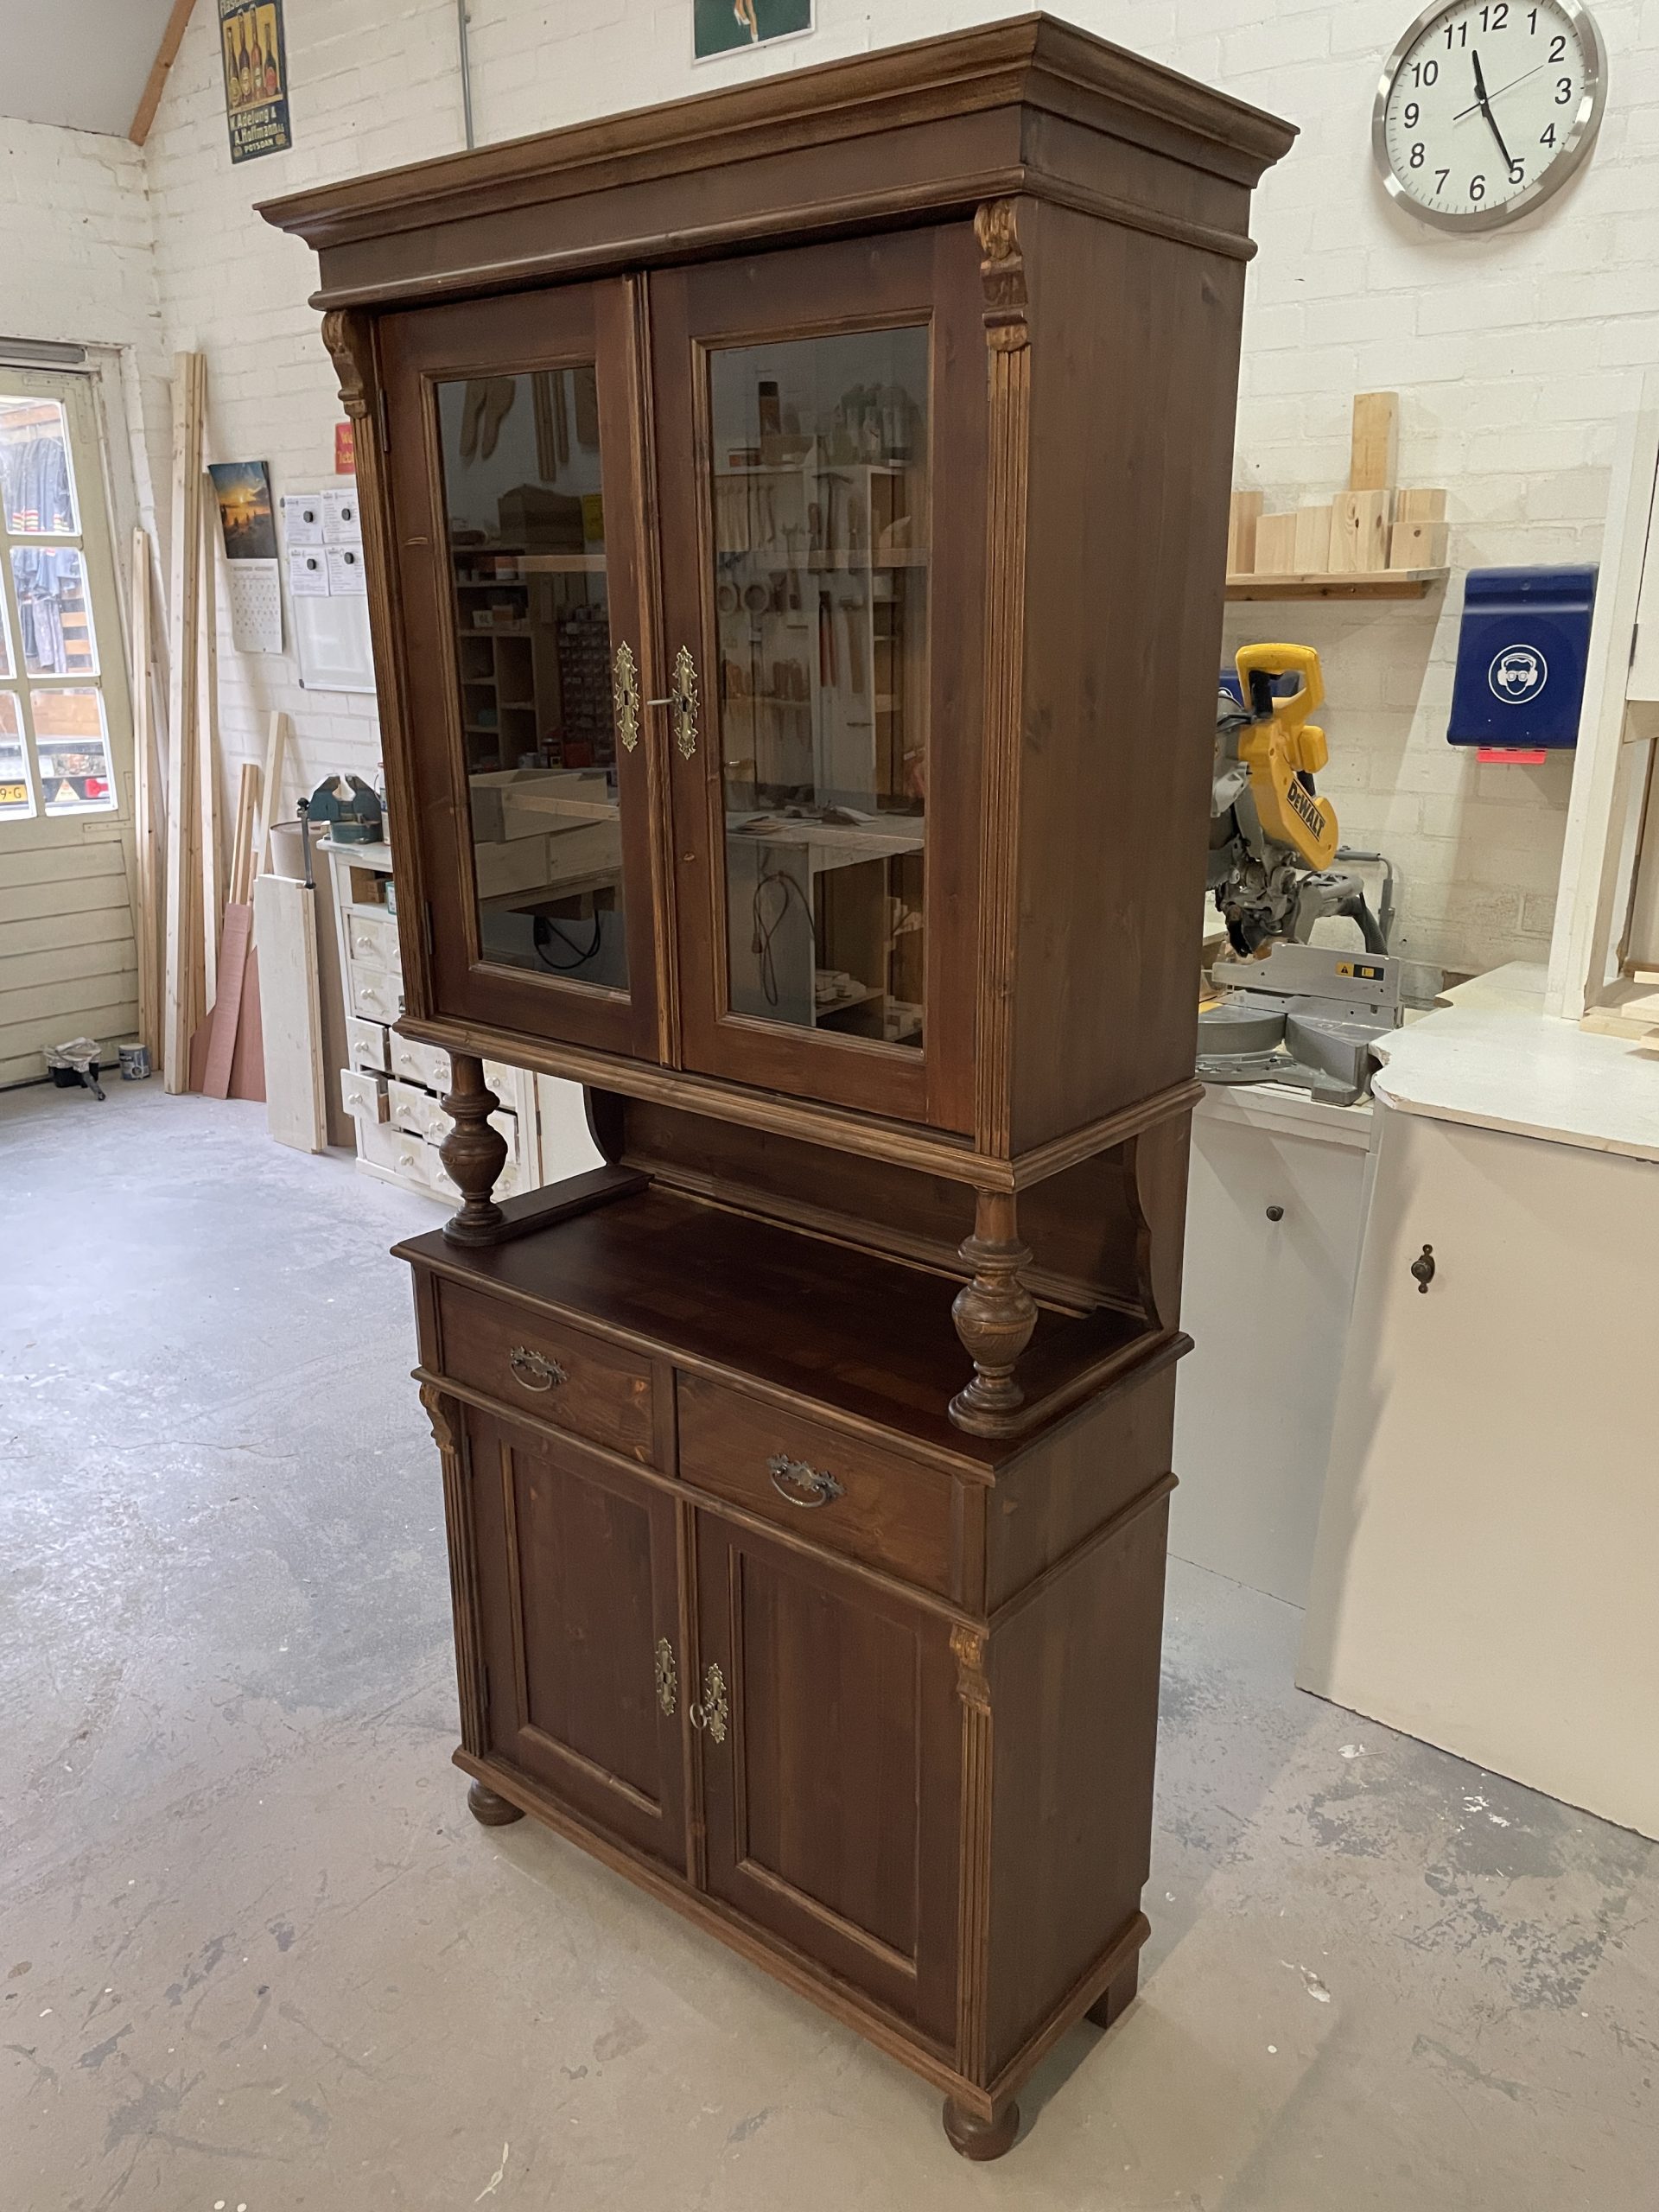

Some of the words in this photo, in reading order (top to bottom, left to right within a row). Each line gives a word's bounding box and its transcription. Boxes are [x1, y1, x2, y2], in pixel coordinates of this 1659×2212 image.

[1479, 3, 1509, 32] 12
[1527, 9, 1537, 35] 1
[1444, 22, 1467, 49] 11
[1548, 36, 1567, 63] 2
[1411, 60, 1439, 87] 10
[1554, 77, 1572, 105] 3
[1404, 103, 1420, 129] 9
[244, 138, 275, 153] POTSDAM
[1540, 123, 1556, 148] 4
[1409, 143, 1425, 168] 8
[1434, 169, 1450, 194] 7
[1508, 158, 1524, 184] 5
[1469, 175, 1485, 201] 6
